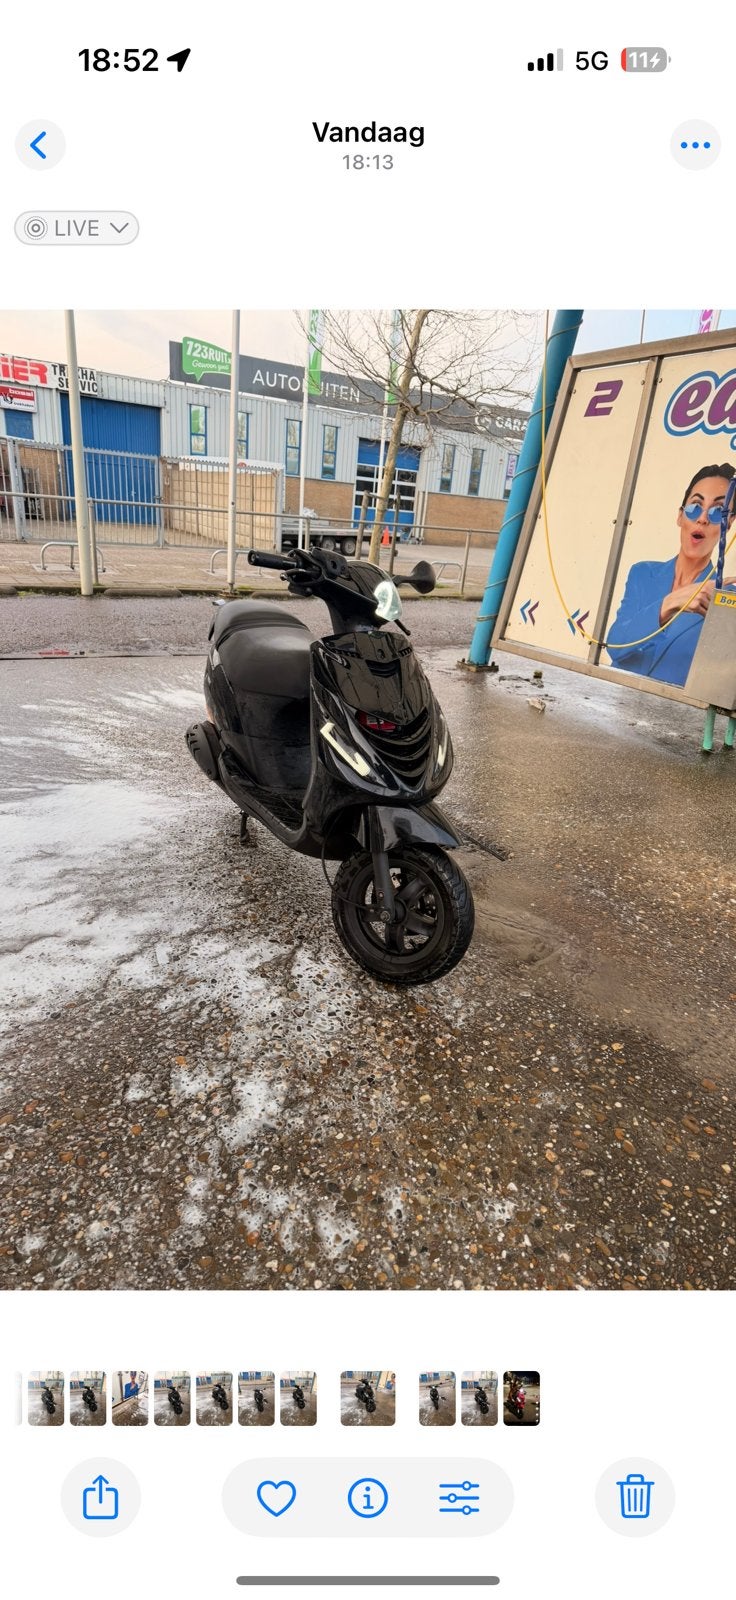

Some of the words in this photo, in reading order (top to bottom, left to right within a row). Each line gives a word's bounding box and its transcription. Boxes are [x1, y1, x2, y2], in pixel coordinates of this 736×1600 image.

[51, 363, 96, 382] TRHA
[252, 369, 360, 403] AUTOITEN
[584, 379, 623, 417] 2
